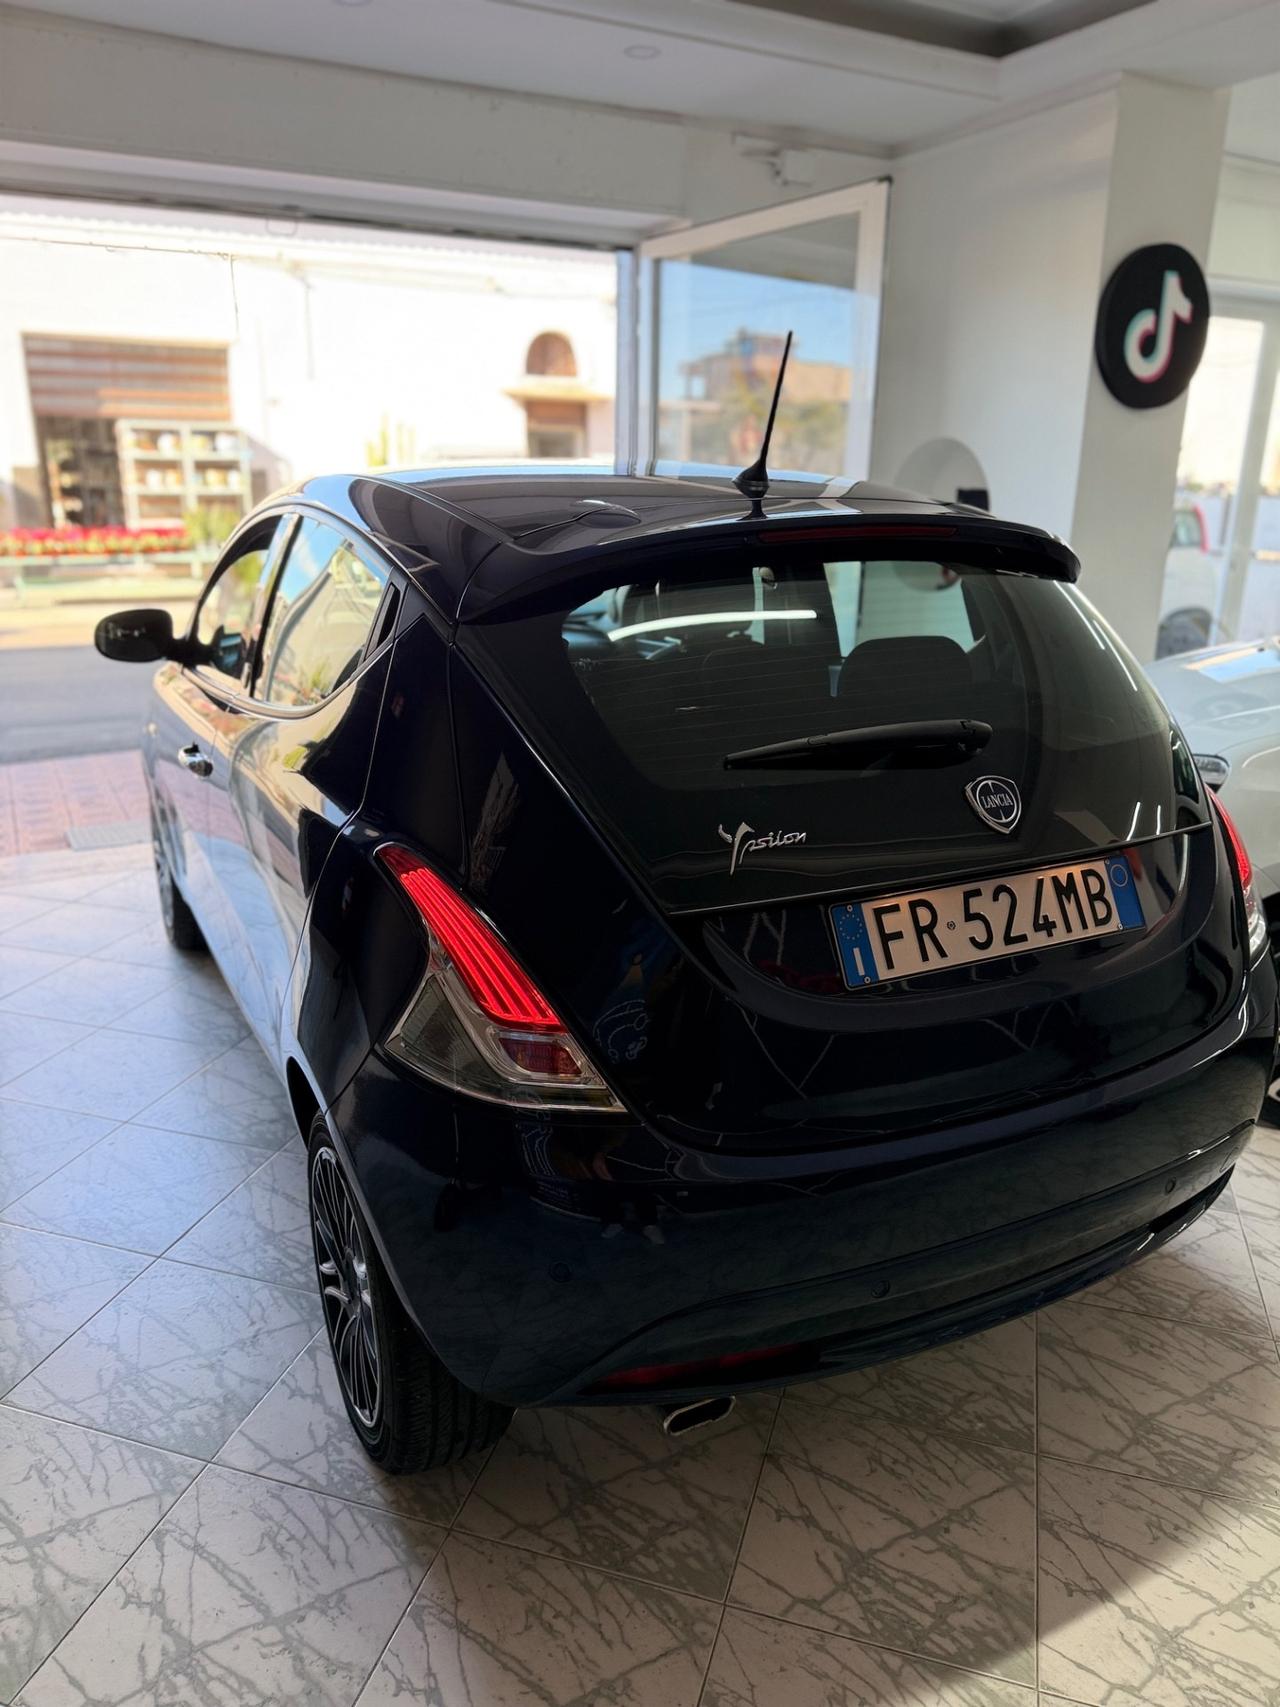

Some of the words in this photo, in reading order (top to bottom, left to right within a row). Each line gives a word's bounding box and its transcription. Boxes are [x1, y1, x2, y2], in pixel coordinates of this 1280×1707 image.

[981, 793, 1014, 809] LANCIA
[718, 821, 807, 876] Ypsilon
[872, 898, 949, 971] FR
[962, 868, 1114, 952] 524MB
[853, 947, 866, 976] I
